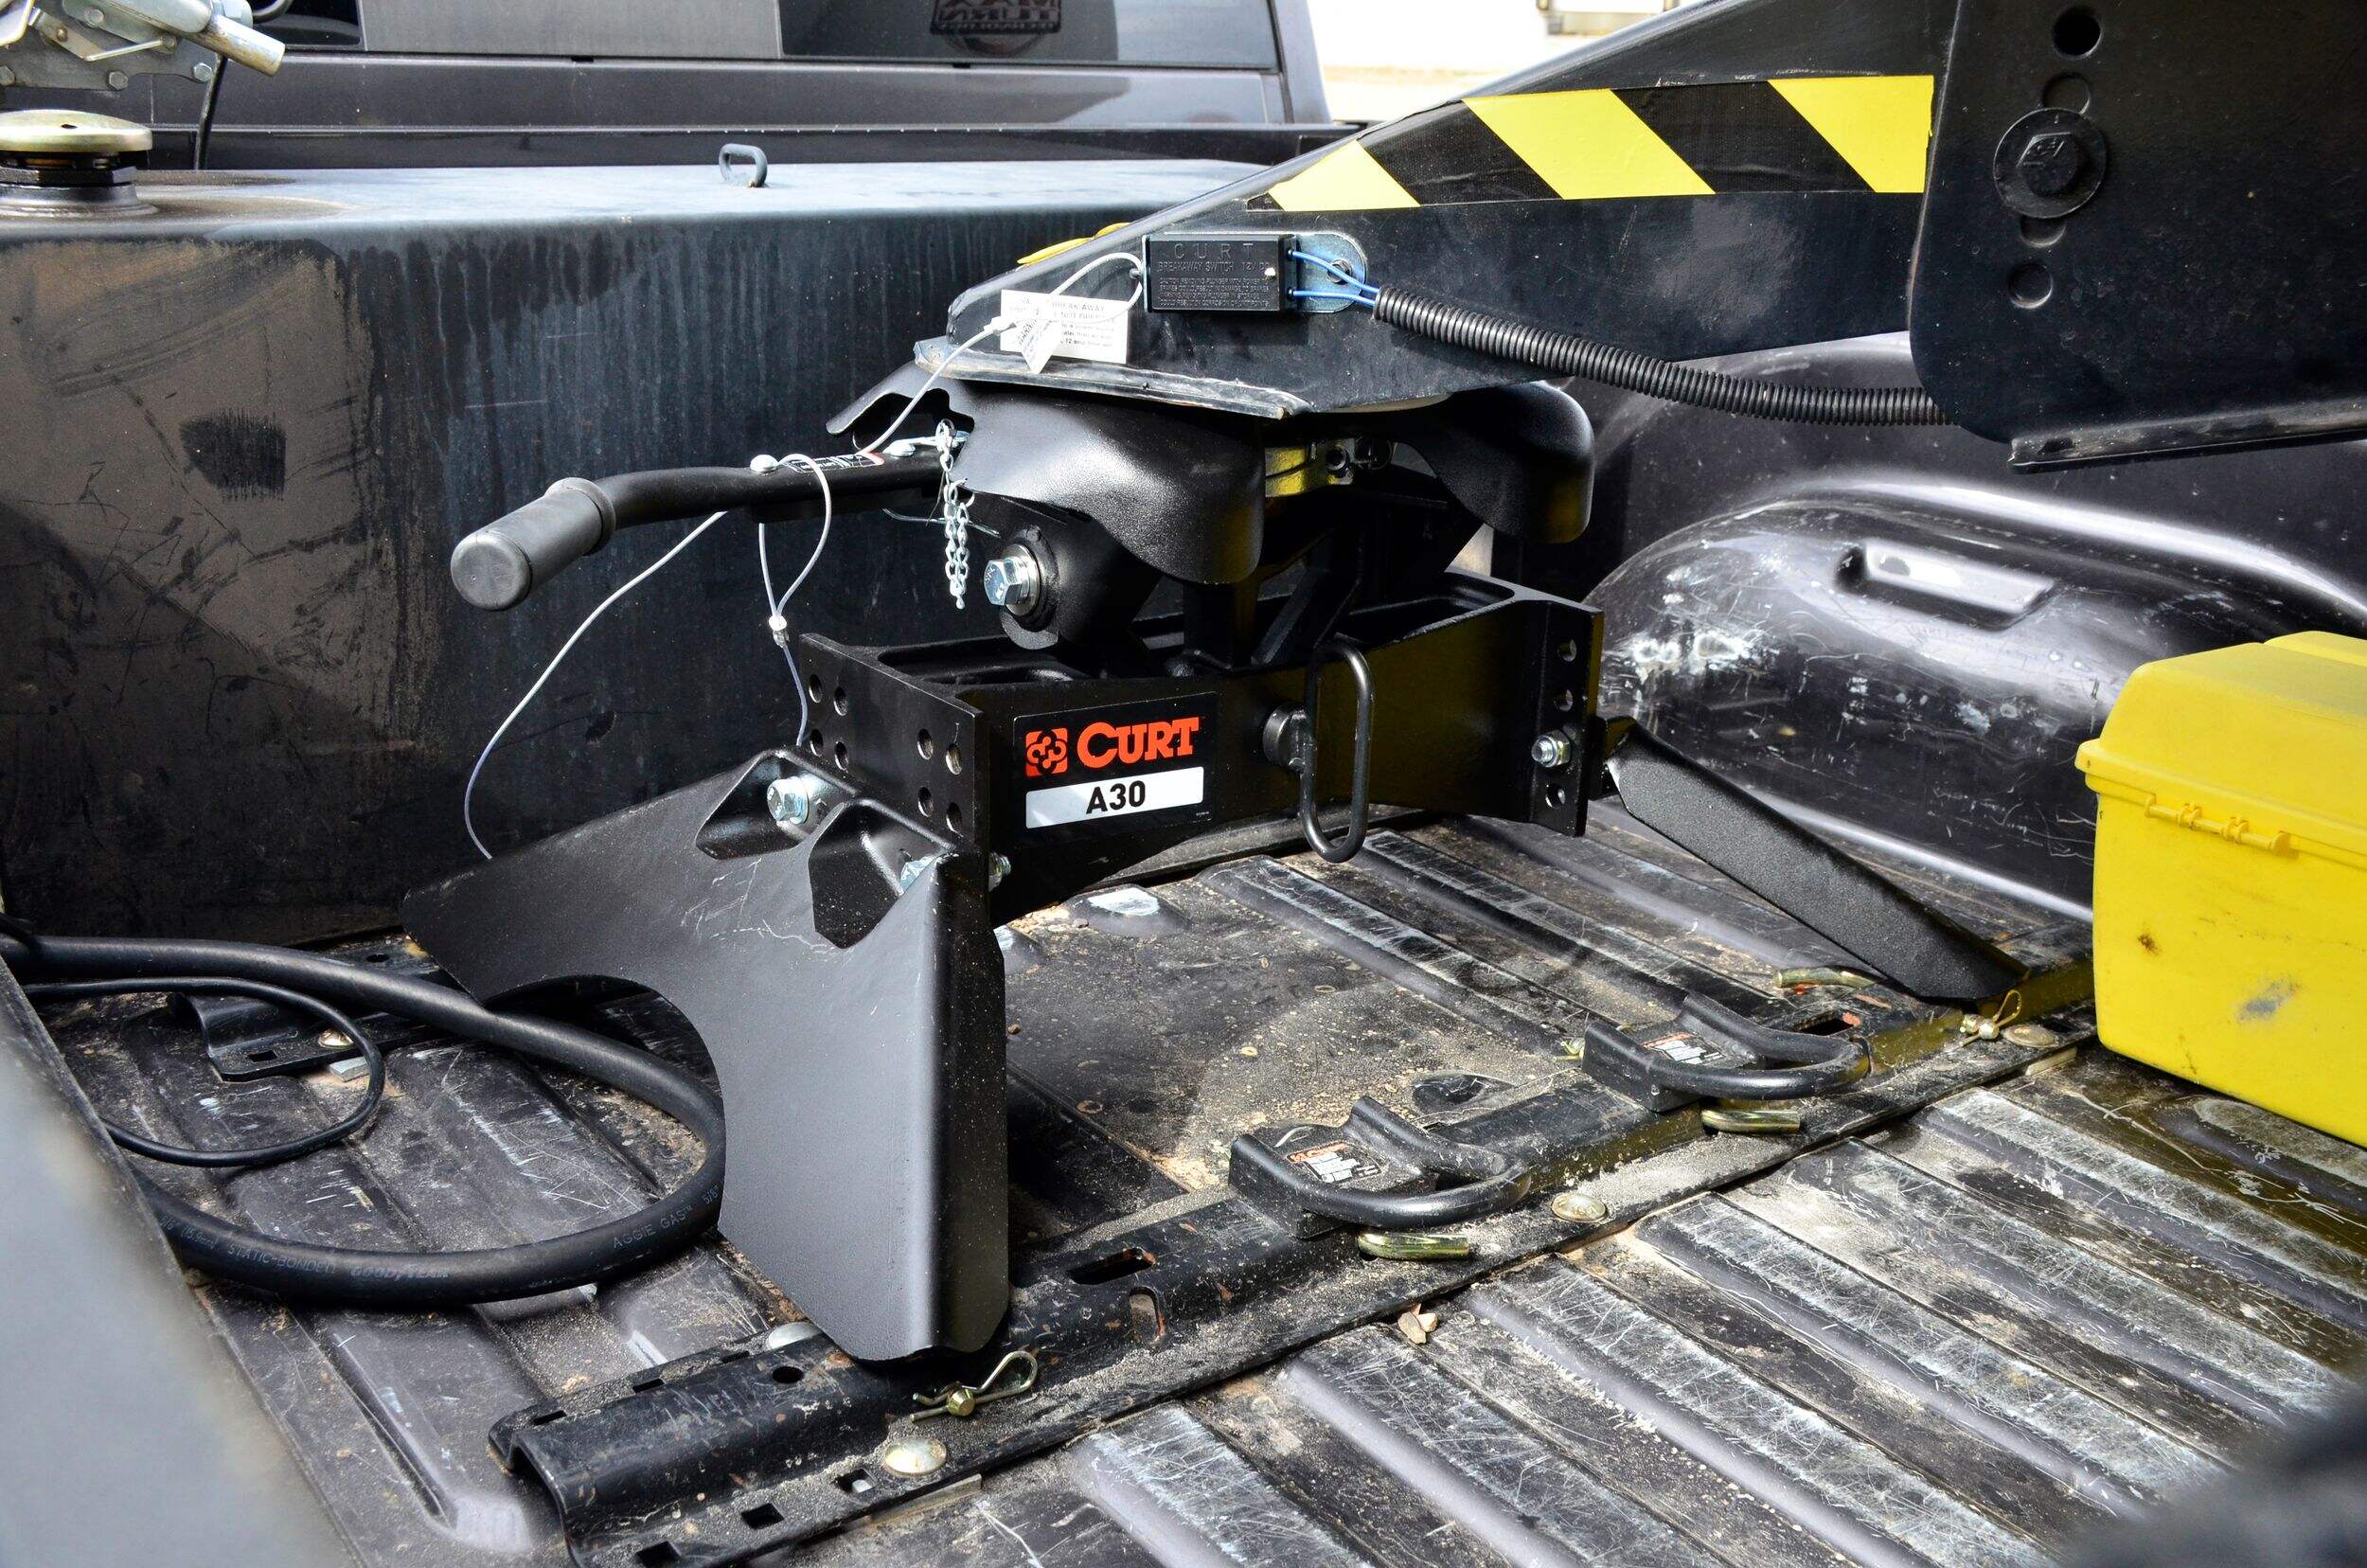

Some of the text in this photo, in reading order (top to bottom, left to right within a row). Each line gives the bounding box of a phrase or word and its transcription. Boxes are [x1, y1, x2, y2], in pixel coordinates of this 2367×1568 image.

[1174, 242, 1253, 258] CURT
[1158, 261, 1203, 272] BREAKAWAY
[1205, 261, 1234, 273] SWITCH
[1077, 717, 1200, 769] CURT
[1085, 779, 1147, 815] A30
[614, 1223, 657, 1249] AGGIE
